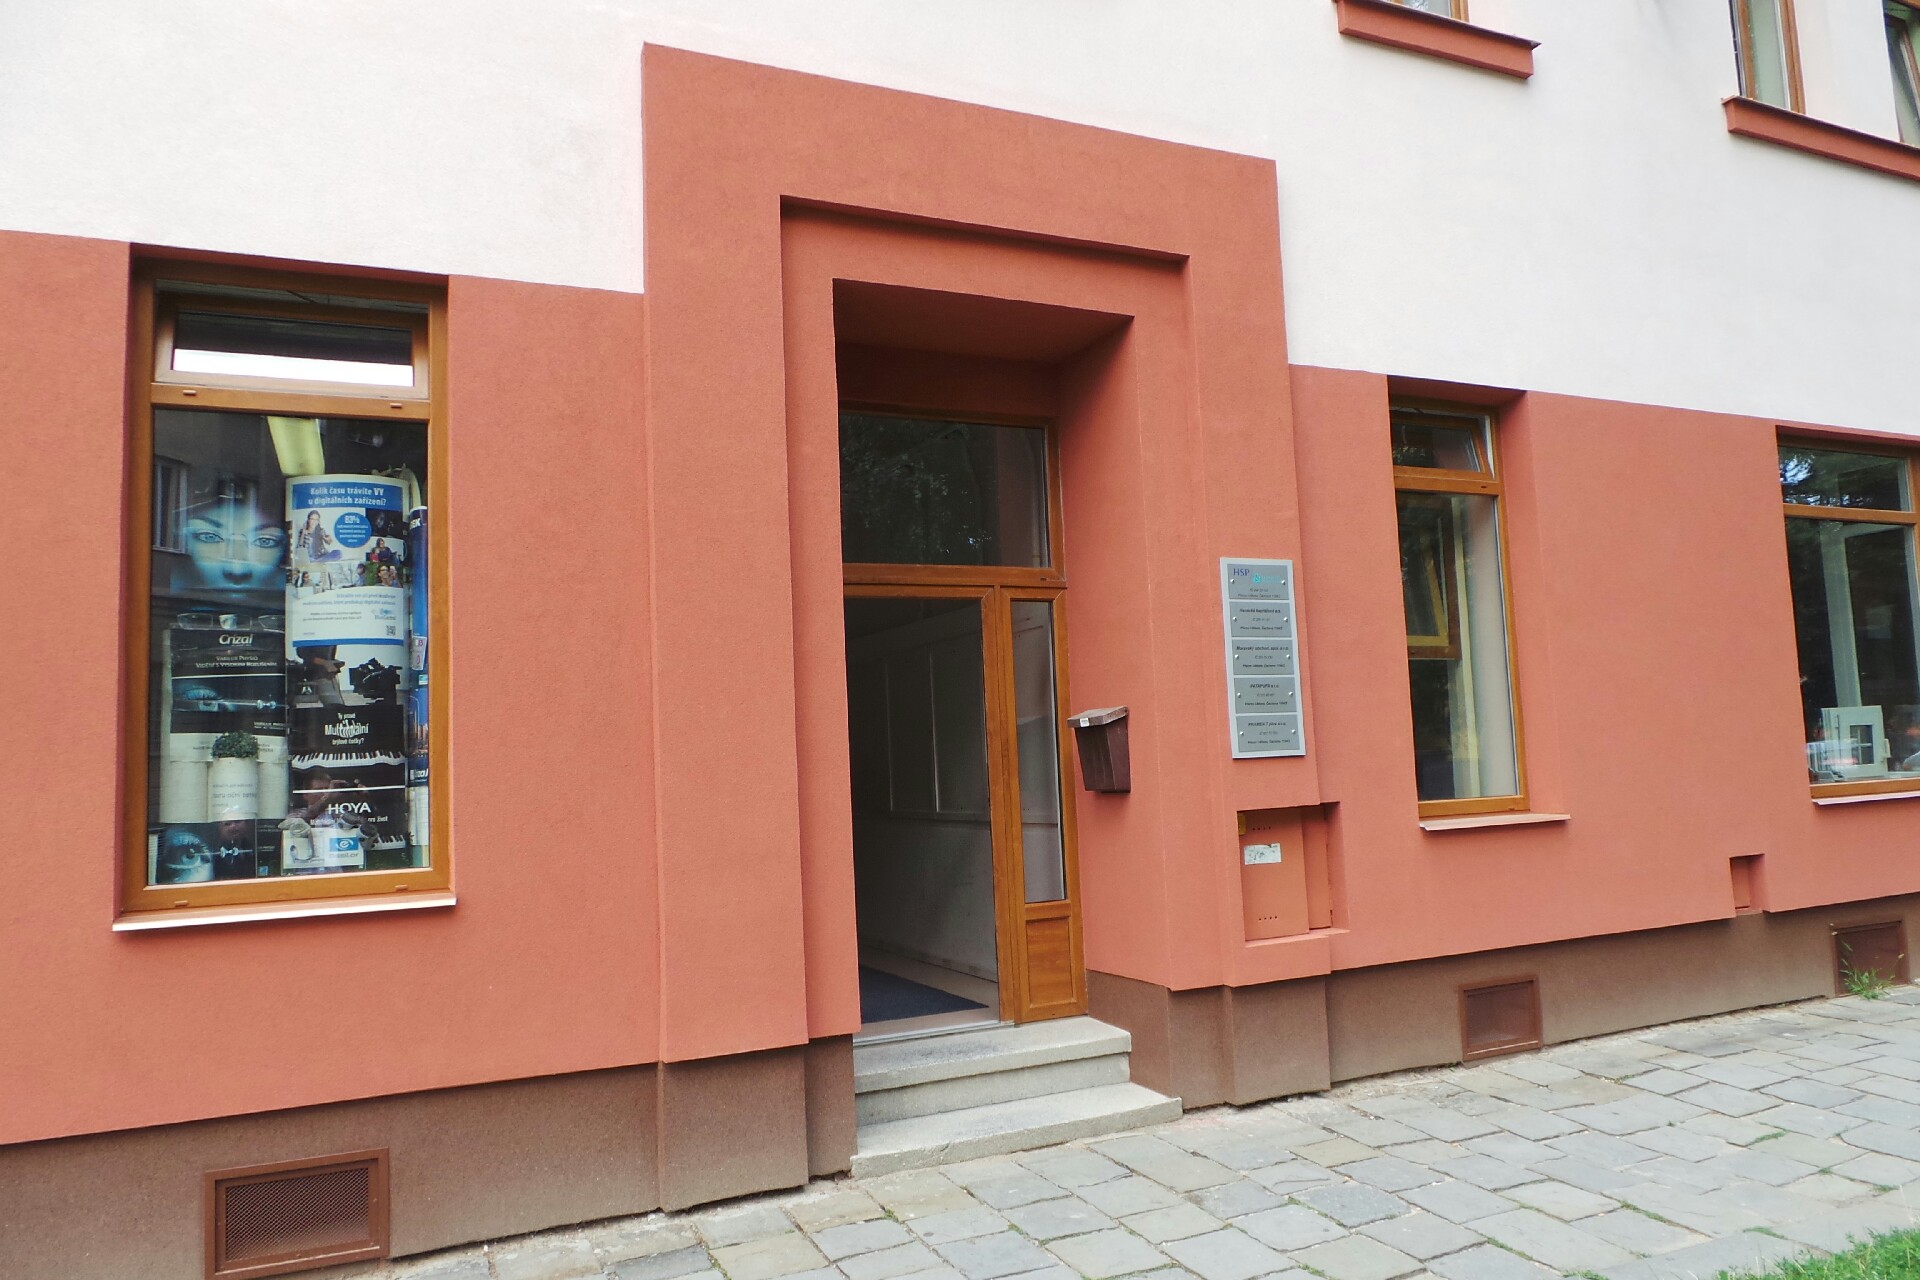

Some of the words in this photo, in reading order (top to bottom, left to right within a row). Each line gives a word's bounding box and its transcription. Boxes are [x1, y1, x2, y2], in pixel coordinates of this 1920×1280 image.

[310, 487, 328, 495] Kolik
[329, 486, 345, 495] času
[373, 487, 384, 496] VY
[1233, 568, 1250, 576] HSP
[219, 634, 254, 645] Crizal
[328, 802, 372, 815] HOYA
